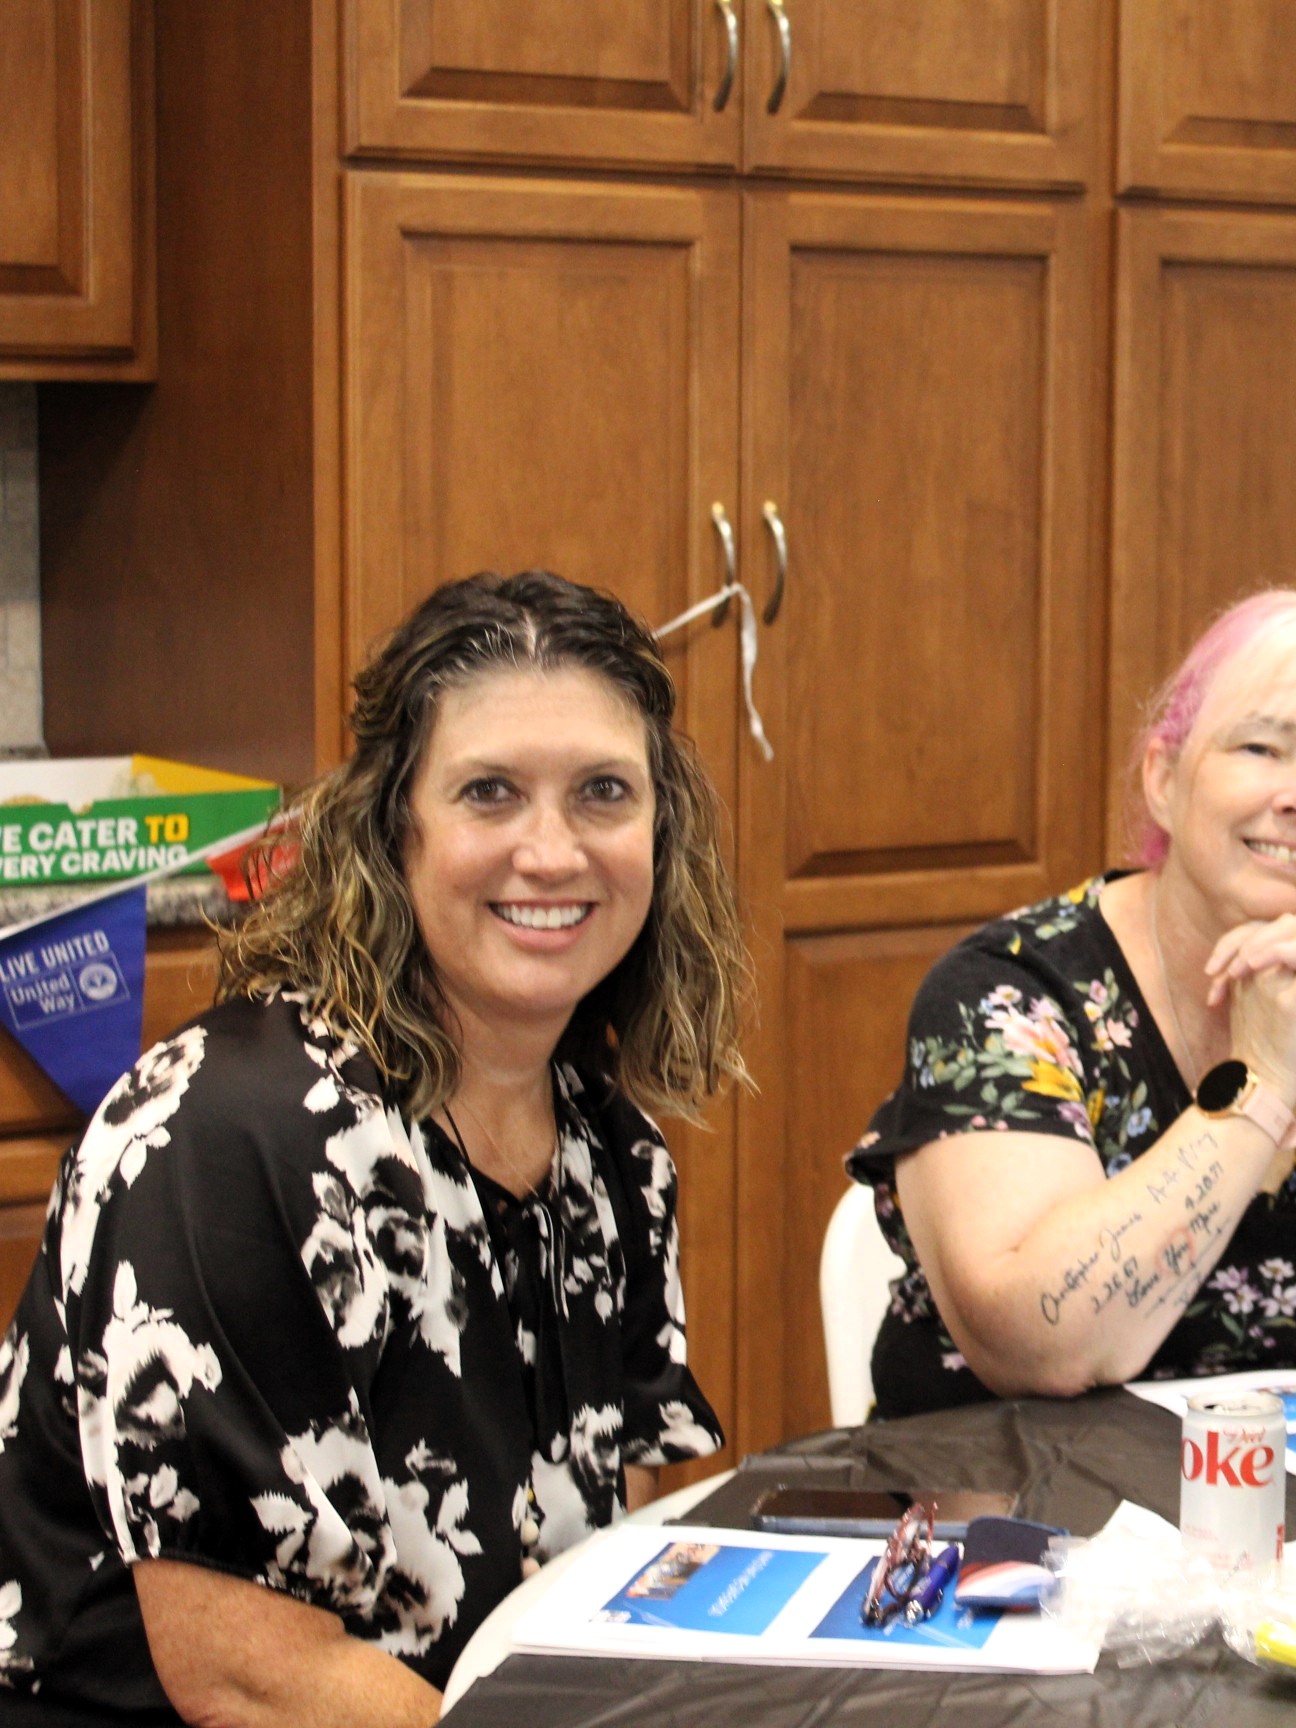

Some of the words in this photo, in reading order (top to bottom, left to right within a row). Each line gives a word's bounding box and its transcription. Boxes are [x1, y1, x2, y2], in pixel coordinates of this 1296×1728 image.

[0, 823, 22, 853] E
[29, 816, 139, 852] CATER
[145, 813, 190, 845] TO
[0, 852, 56, 880] ERY
[60, 844, 188, 876] CRAVING
[0, 951, 39, 983] LIVE
[41, 930, 110, 969] UNITED
[11, 972, 71, 1006] United
[40, 993, 75, 1015] Way
[1126, 1272, 1160, 1309] Love
[1163, 1241, 1190, 1276] You
[1189, 1201, 1221, 1235] More
